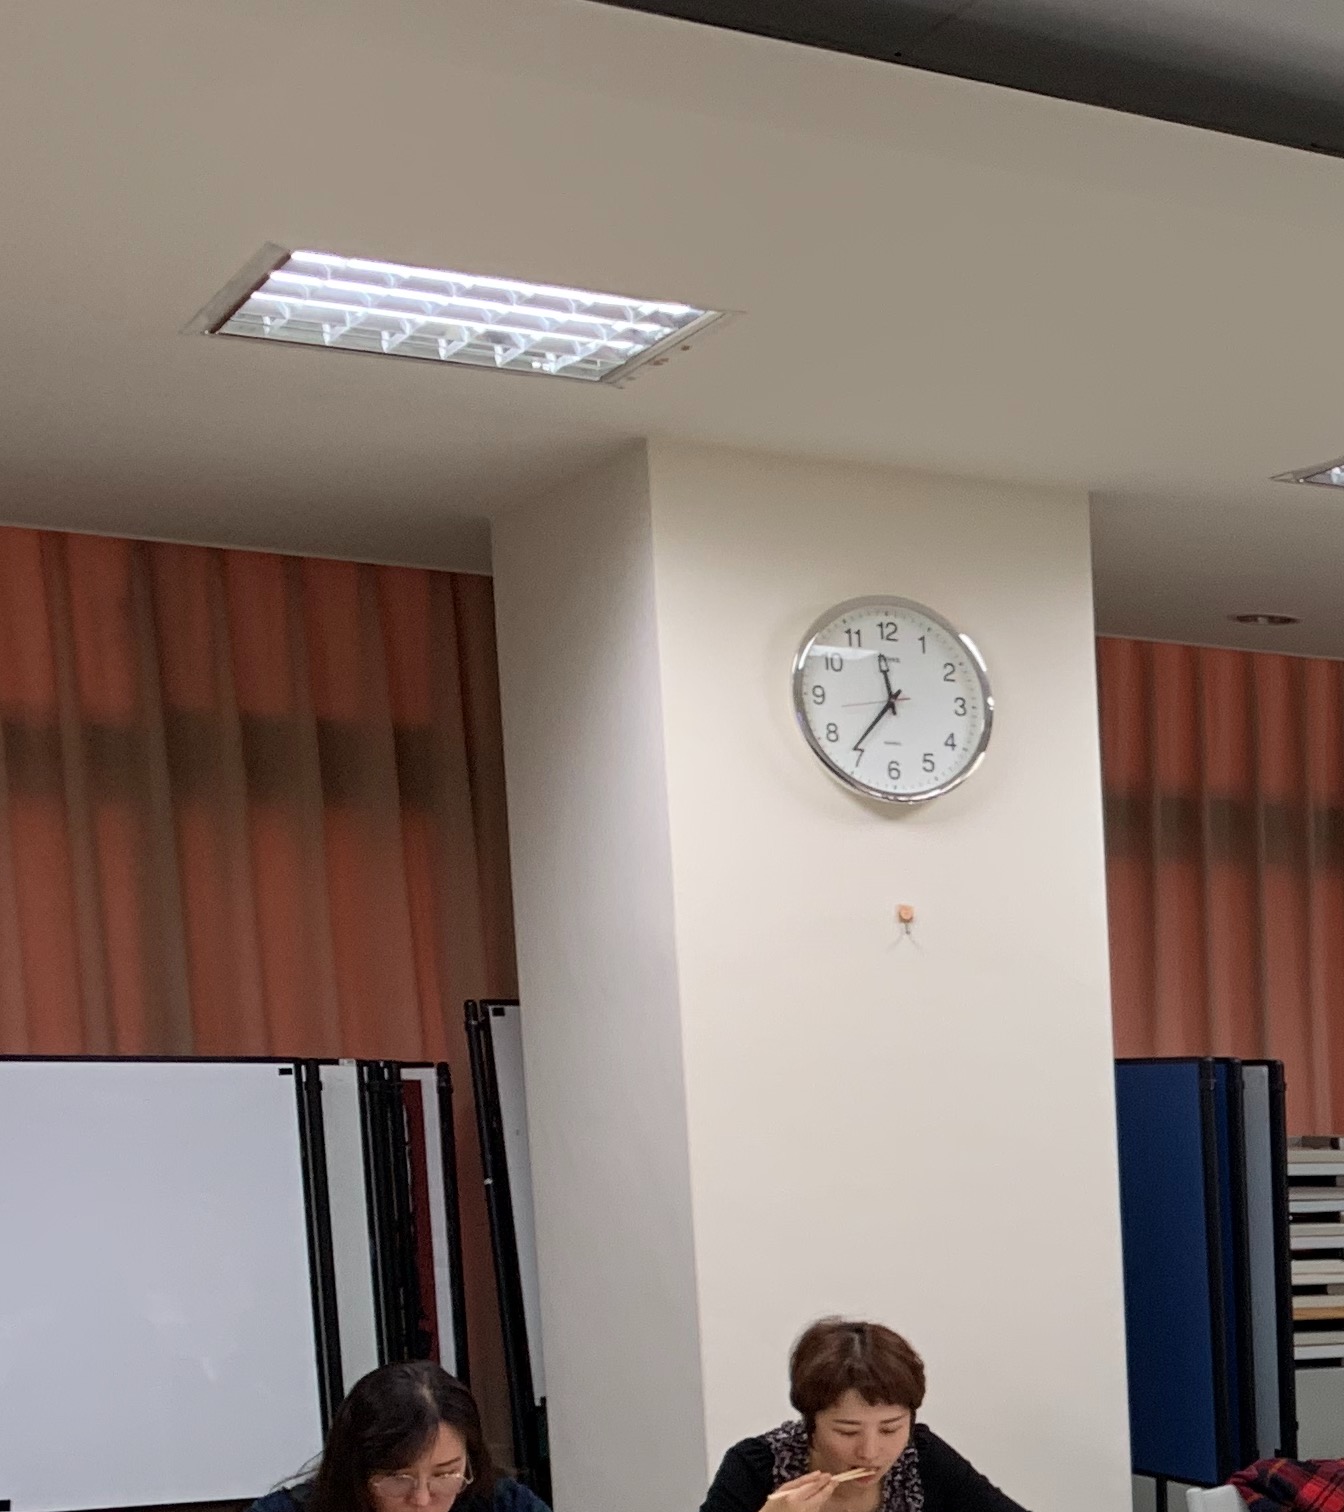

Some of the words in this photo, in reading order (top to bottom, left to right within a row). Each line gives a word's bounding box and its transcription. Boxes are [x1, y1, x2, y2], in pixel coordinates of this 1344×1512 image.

[845, 629, 862, 647] 11
[876, 622, 898, 641] 12
[918, 636, 926, 654] 1
[825, 652, 843, 672] 10
[943, 663, 955, 682] 2
[812, 685, 825, 705] 9
[954, 697, 967, 716] 3
[826, 723, 839, 742] 8
[944, 733, 956, 751] 4
[853, 748, 864, 767] 7
[922, 753, 935, 772] 5
[888, 761, 901, 780] 6
